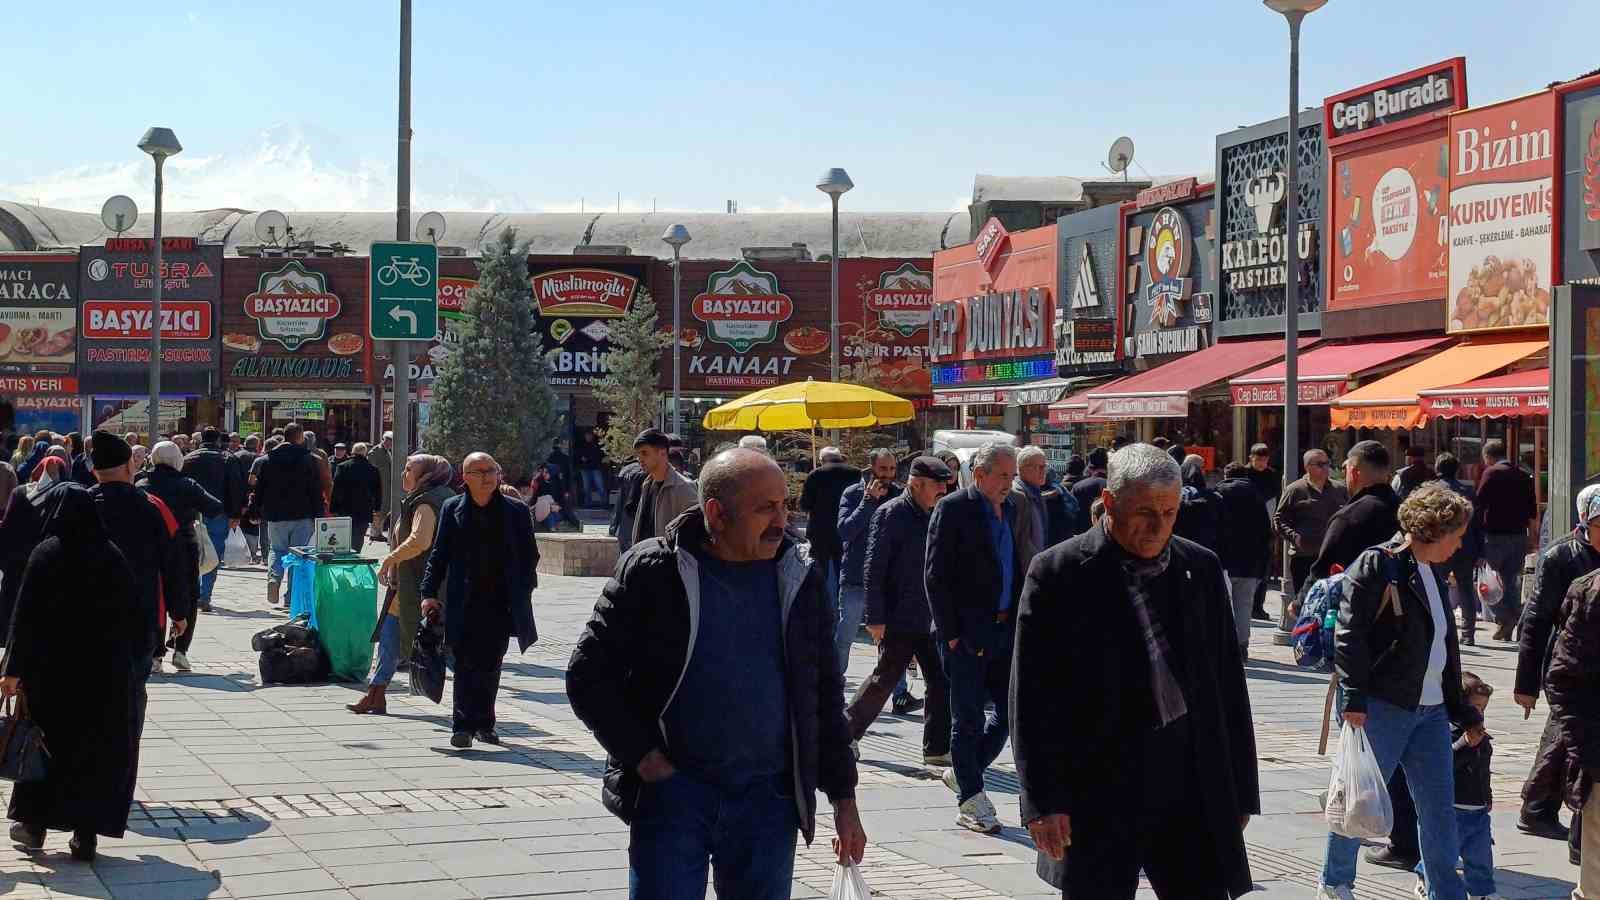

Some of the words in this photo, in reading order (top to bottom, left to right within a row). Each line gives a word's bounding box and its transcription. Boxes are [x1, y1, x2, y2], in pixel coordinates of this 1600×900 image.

[1332, 102, 1368, 129] Cep
[1374, 75, 1449, 117] Burada
[1456, 120, 1552, 176] Bizim
[1450, 185, 1552, 227] KURUYEMİŞ
[1222, 223, 1312, 270] KALEÖÜ
[1453, 234, 1473, 247] KAHVE
[1479, 229, 1514, 248] ŞEKERLEME
[1231, 265, 1302, 290] PASTIRM
[255, 298, 329, 316] BAŞYAZICI
[703, 300, 779, 317] BAŞYAZICI
[89, 309, 200, 334] BAŞYAZICI
[929, 302, 957, 357] CEP
[87, 348, 152, 361] PASTIRM
[688, 356, 797, 375] KANAAT
[17, 398, 80, 409] BAŞYAZIC
